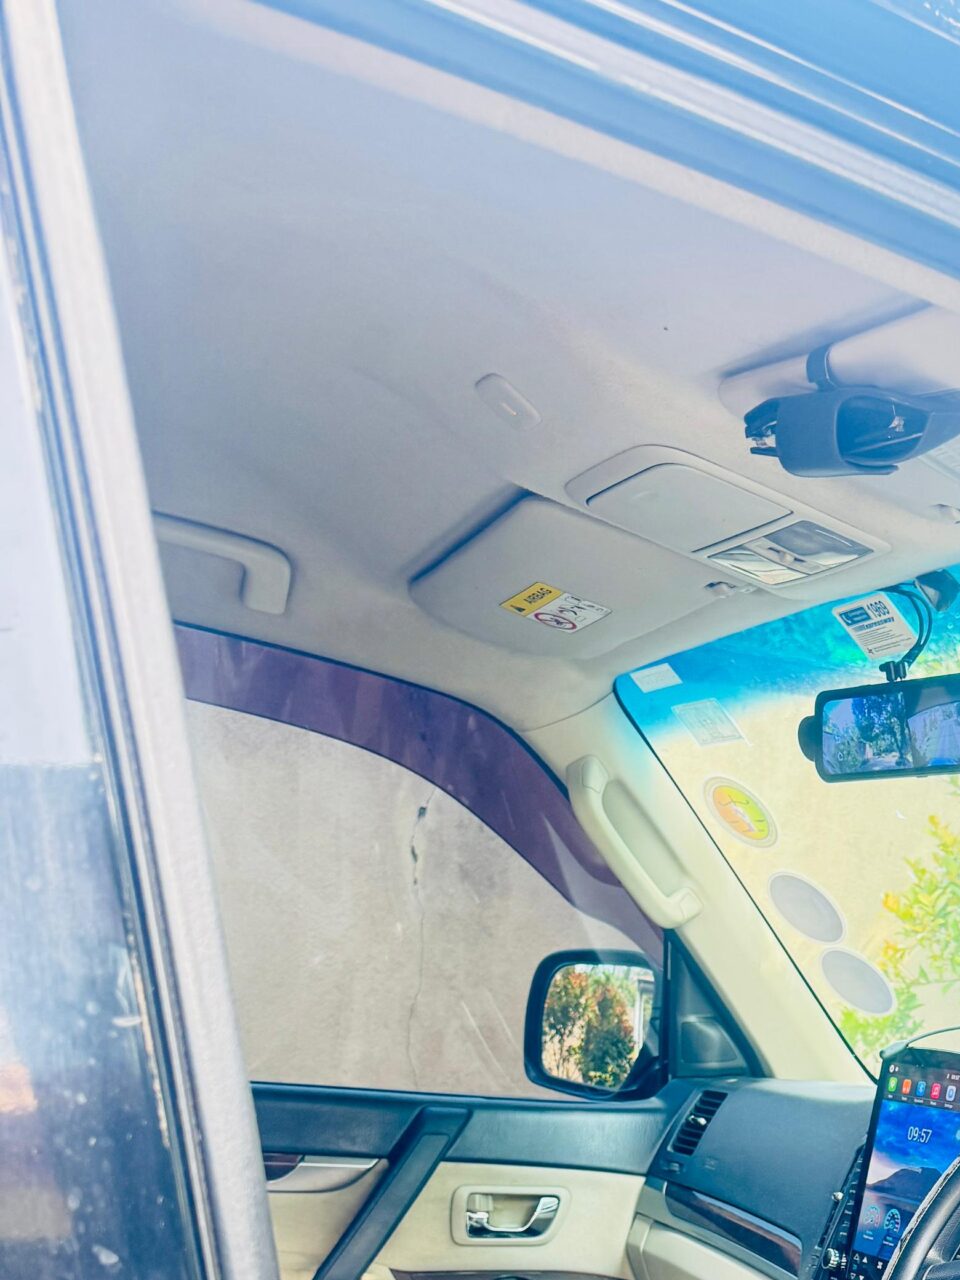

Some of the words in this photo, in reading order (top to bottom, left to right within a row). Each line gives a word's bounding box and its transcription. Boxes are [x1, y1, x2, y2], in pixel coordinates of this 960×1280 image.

[523, 587, 552, 605] AIRBAG
[866, 600, 890, 618] 1969
[907, 1126, 933, 1143] 09:57
